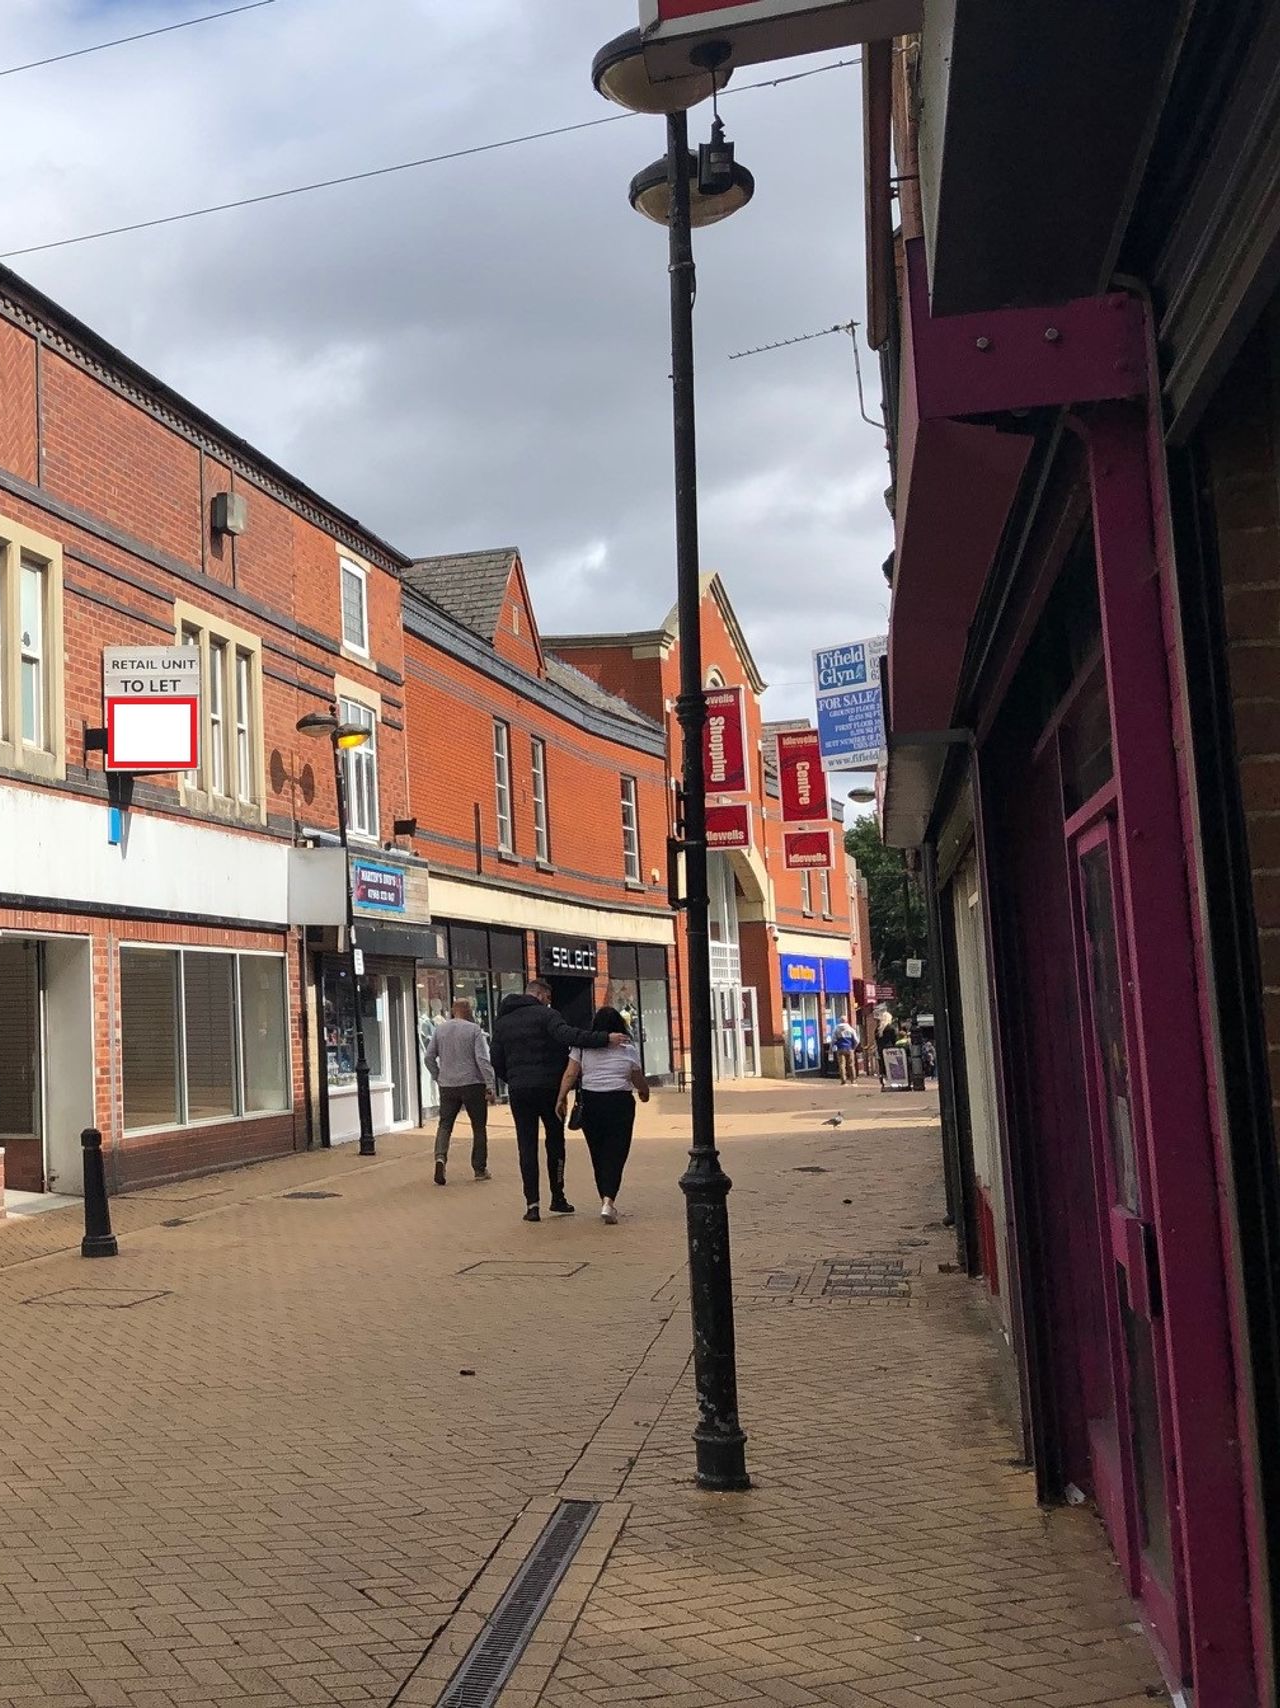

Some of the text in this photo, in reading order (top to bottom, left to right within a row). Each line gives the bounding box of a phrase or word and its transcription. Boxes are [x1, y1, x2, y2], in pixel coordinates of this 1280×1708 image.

[112, 659, 196, 669] RETAIL UNIT
[820, 645, 864, 669] Fifield
[120, 679, 181, 692] TO LET
[820, 668, 855, 686] Glyn
[819, 696, 841, 711] FOR
[709, 716, 727, 782] Shopping
[796, 761, 811, 805] Centre
